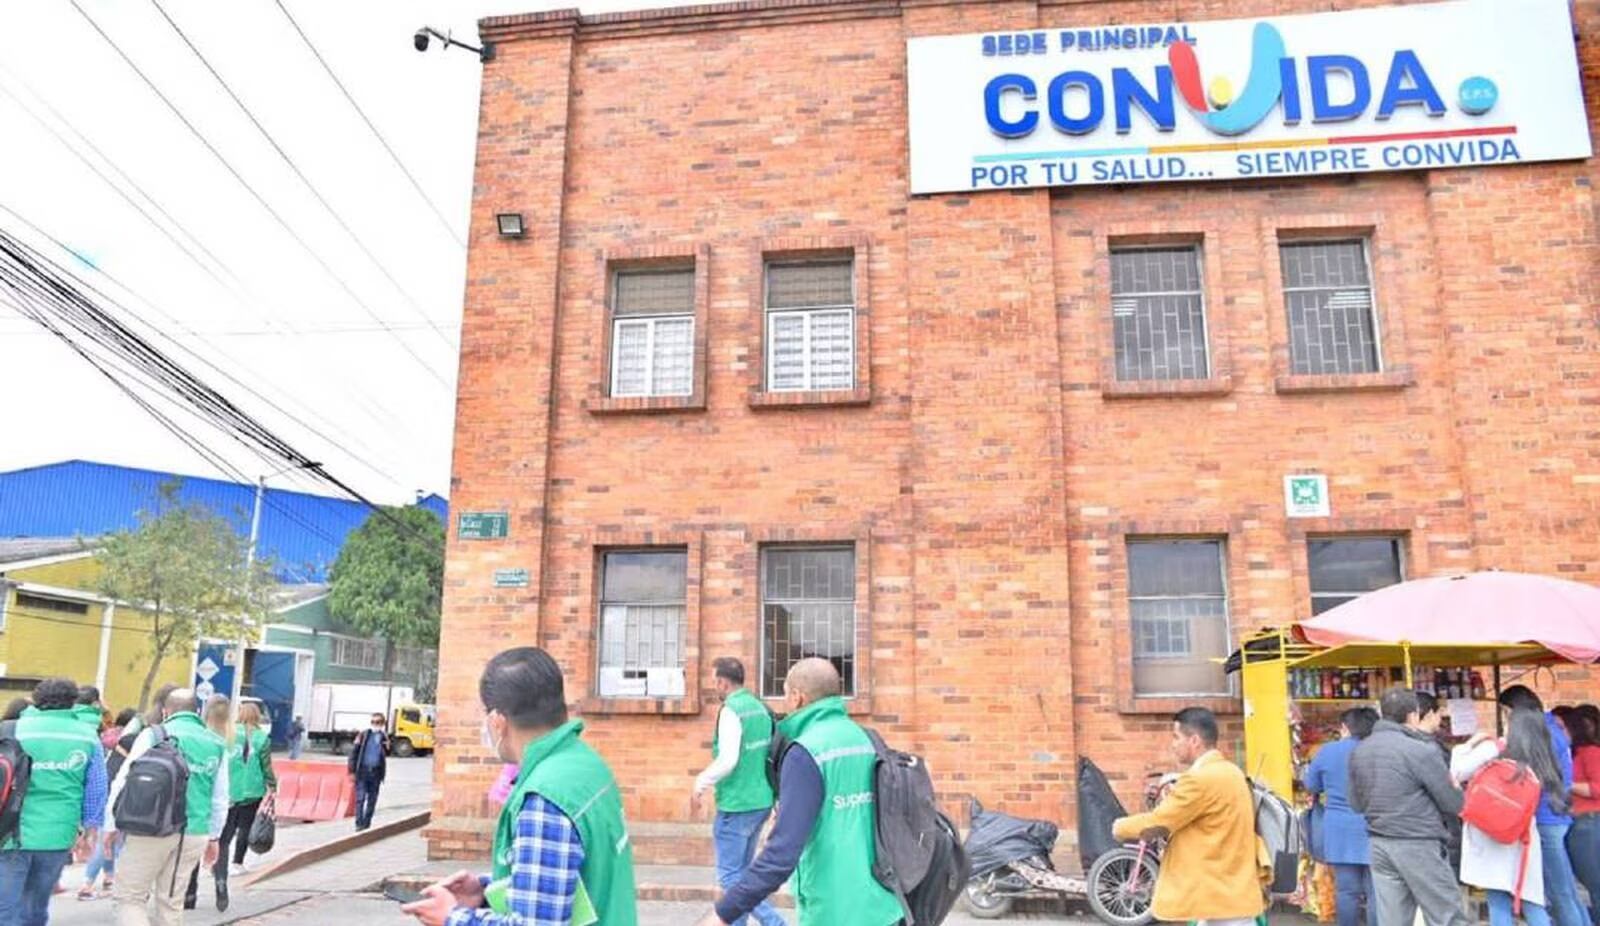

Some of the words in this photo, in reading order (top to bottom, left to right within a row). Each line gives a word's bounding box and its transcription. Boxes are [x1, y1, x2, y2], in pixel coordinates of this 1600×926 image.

[982, 32, 1048, 57] SEDE
[1059, 25, 1198, 53] PRINCIPAL
[971, 164, 1029, 188] POR
[1041, 161, 1079, 184] TU
[1092, 156, 1215, 181] SALUD...
[1236, 149, 1370, 176] SIEMPRE
[1382, 138, 1522, 168] CONVIDA
